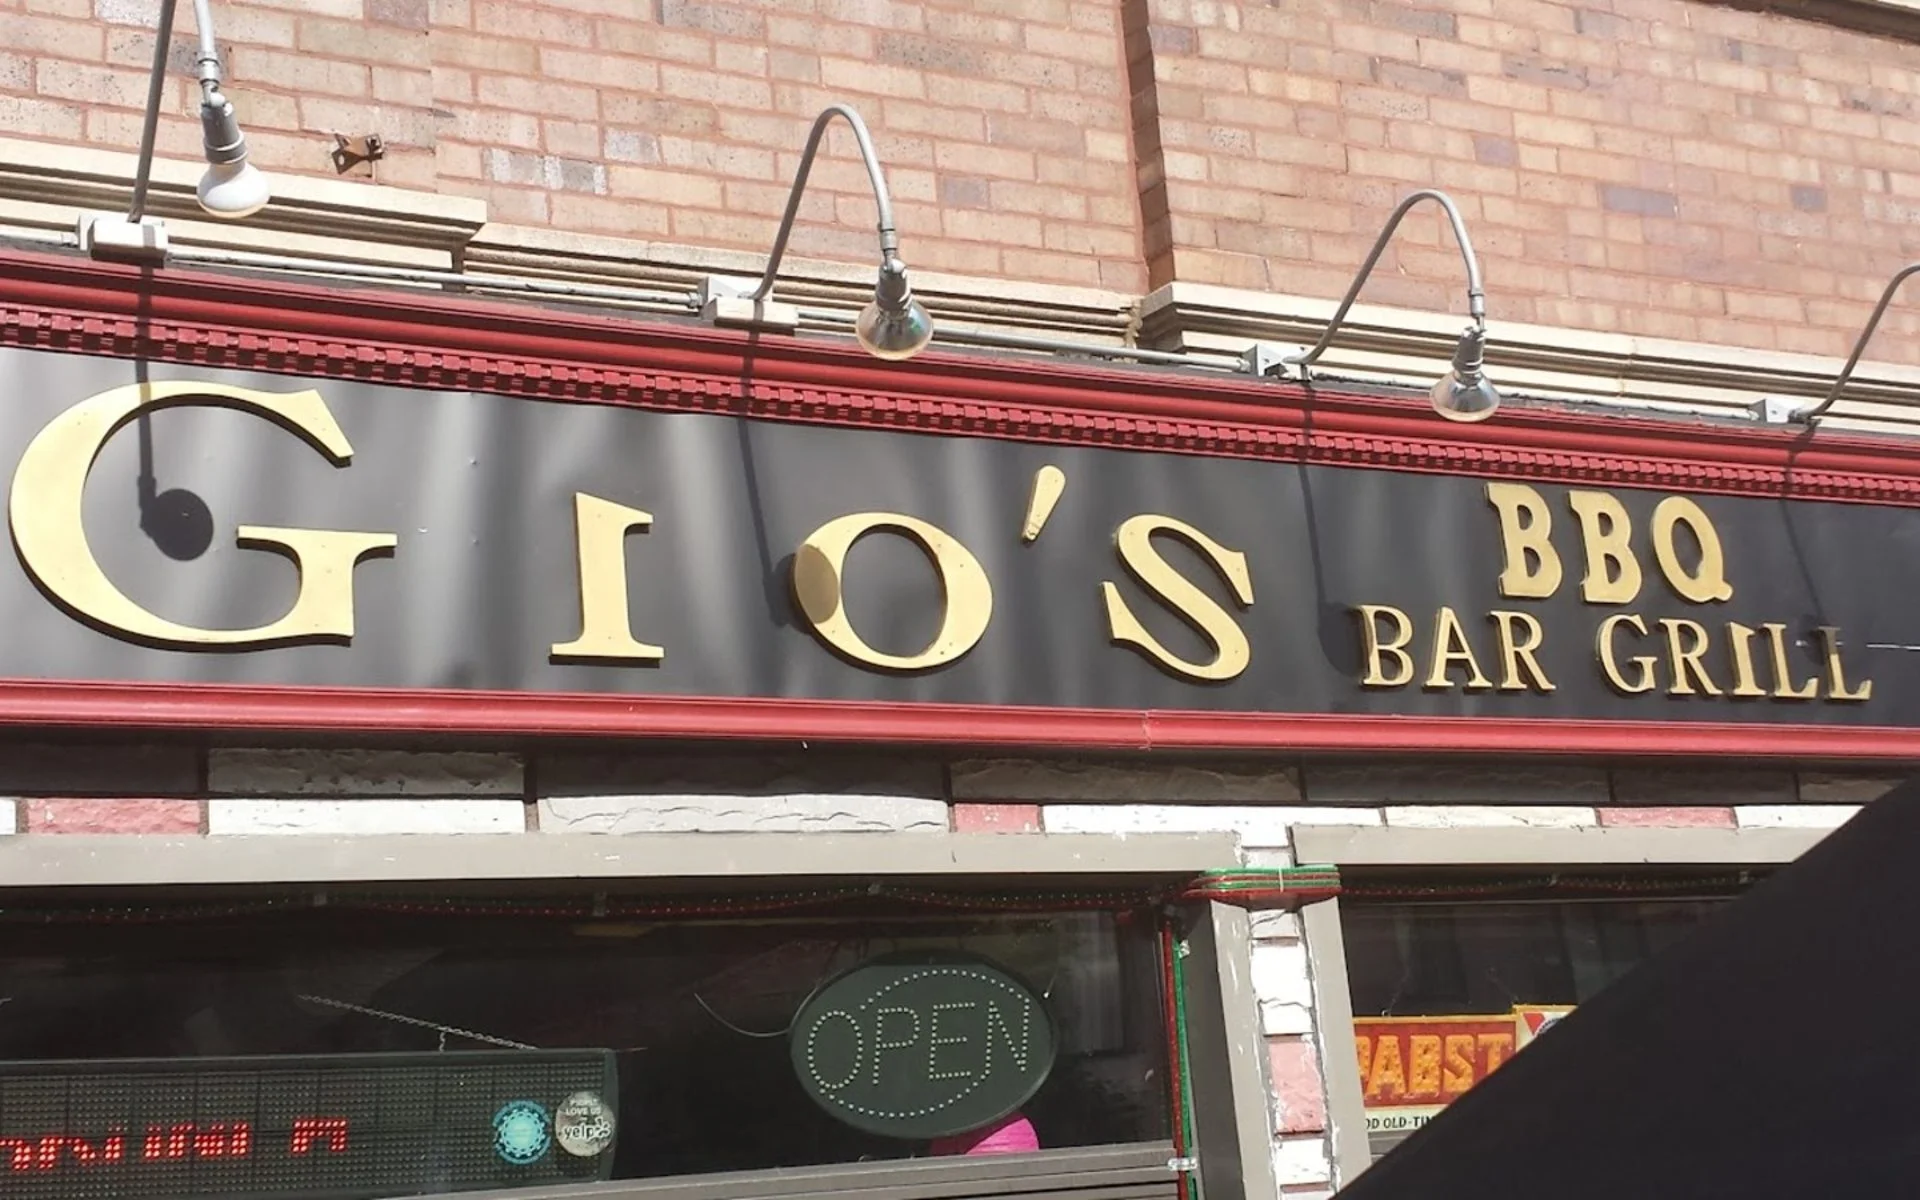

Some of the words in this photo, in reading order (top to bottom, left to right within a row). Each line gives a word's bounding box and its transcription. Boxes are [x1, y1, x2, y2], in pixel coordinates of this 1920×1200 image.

[1486, 482, 1733, 604] BBQ
[1358, 603, 1556, 692] BAR
[1595, 612, 1873, 701] GRILL
[807, 1000, 1031, 1090] OPEN
[561, 1122, 595, 1141] yelp
